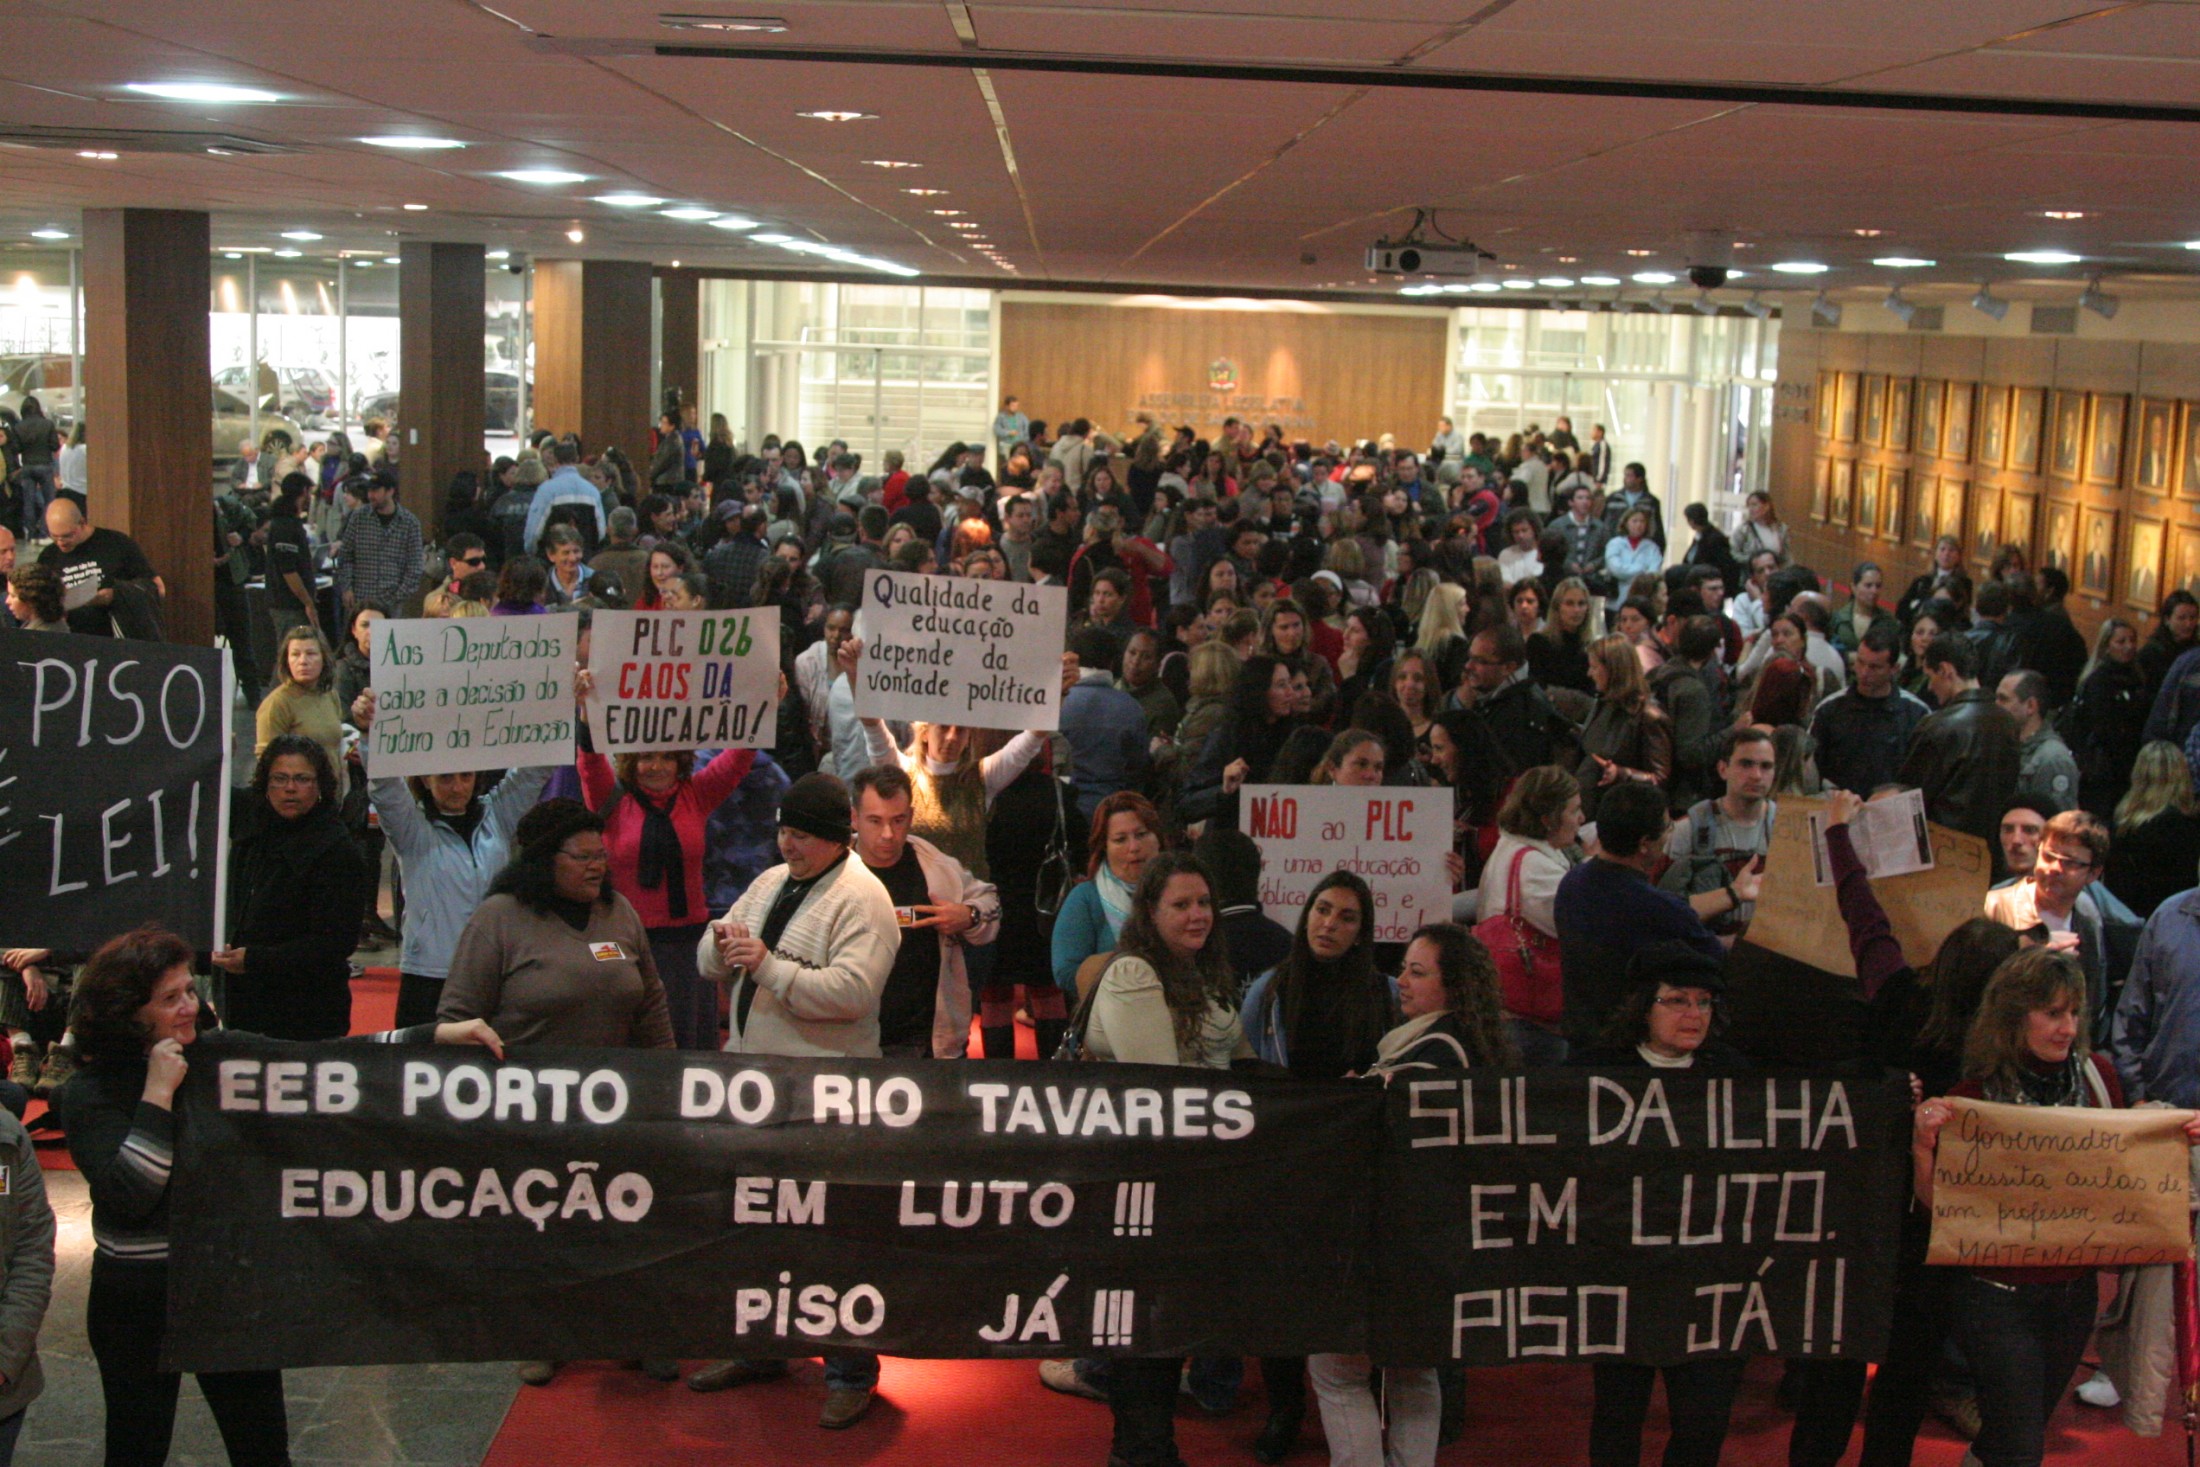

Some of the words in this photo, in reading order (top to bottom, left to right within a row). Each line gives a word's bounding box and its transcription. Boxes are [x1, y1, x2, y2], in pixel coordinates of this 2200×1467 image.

[873, 574, 993, 611] Qualidade
[1011, 586, 1040, 615] da
[380, 628, 424, 666] Aos
[440, 622, 562, 669] Deputados
[632, 617, 686, 657] PLC
[698, 615, 753, 657] 026
[912, 607, 1014, 642] educação
[869, 633, 954, 670] depende
[982, 643, 1009, 671] da
[17, 657, 206, 749] PISO
[379, 673, 426, 711] cabe
[436, 687, 448, 707] a
[455, 669, 526, 706] decisão
[535, 664, 559, 700] do
[618, 662, 691, 700] CAOS
[702, 662, 733, 699] DA
[867, 668, 949, 697] vontade
[967, 674, 1047, 711] política
[374, 714, 434, 755] Futuro
[446, 713, 471, 749] da
[482, 707, 573, 747] Educação.
[606, 699, 769, 745] EDUCAÇÃO!
[39, 780, 201, 896] LEI!
[1321, 821, 1346, 841] ao
[1366, 799, 1414, 841] PLC
[1284, 857, 1323, 874] uma
[1336, 845, 1421, 878] educação
[1401, 894, 1414, 909] e
[218, 1059, 361, 1115] EEB
[402, 1060, 629, 1125] PORTO
[680, 1067, 775, 1125] DO
[812, 1073, 923, 1128] RIO
[967, 1082, 1256, 1141] TAVARES
[1409, 1076, 1557, 1149] SUL
[1588, 1075, 1681, 1149] DA
[1706, 1078, 1858, 1151] ILHA
[1960, 1108, 2128, 1174] Governador
[281, 1161, 654, 1232] EDUCAÇÃO
[733, 1176, 827, 1226] EM
[898, 1180, 1076, 1228] LUTO
[1937, 1165, 2052, 1191] necessita
[2064, 1166, 2147, 1192] aulas
[2157, 1172, 2183, 1194] de
[1471, 1177, 1578, 1250] EM
[1631, 1171, 1837, 1246] LUTO.
[1935, 1204, 1981, 1219] um
[1997, 1200, 2097, 1240] professor
[2111, 1204, 2140, 1225] de
[978, 1272, 1070, 1342] JÁ
[1451, 1285, 1629, 1360] PISO
